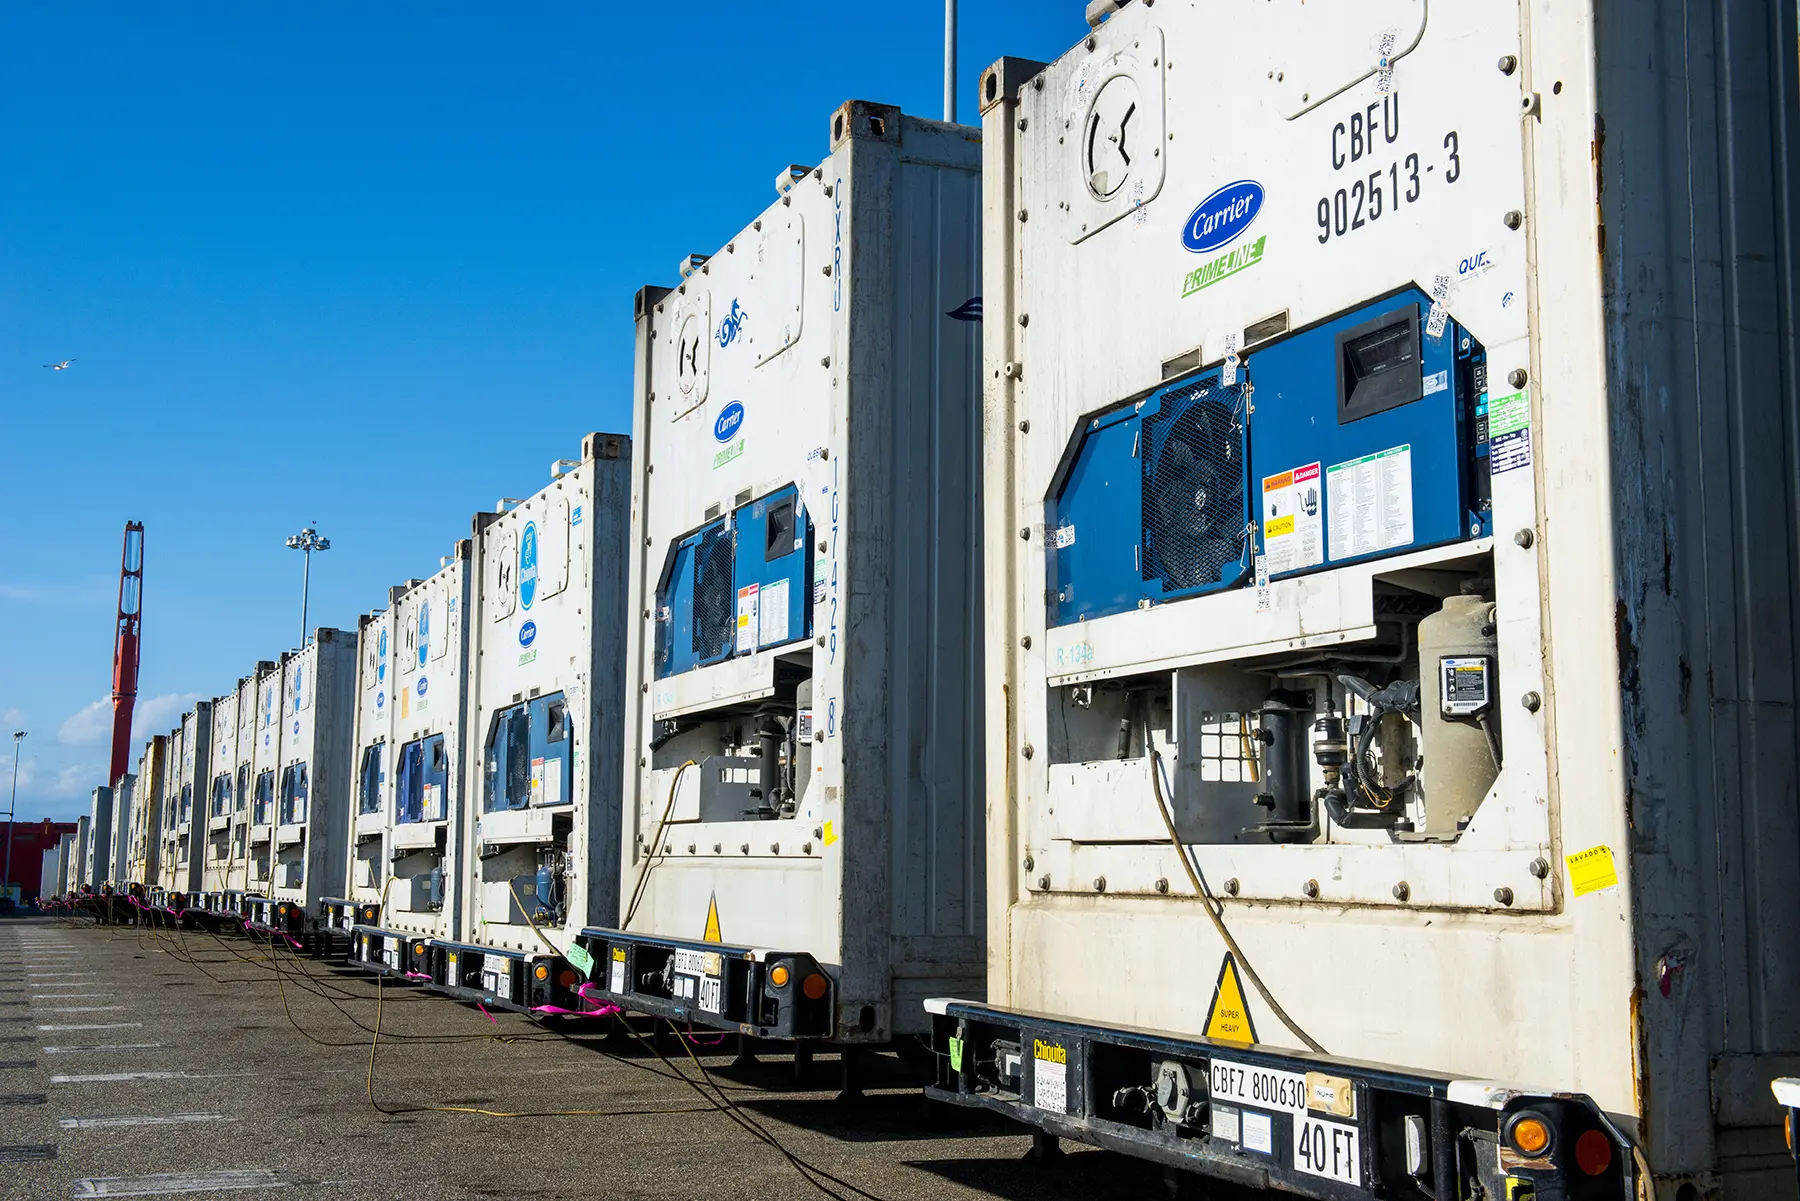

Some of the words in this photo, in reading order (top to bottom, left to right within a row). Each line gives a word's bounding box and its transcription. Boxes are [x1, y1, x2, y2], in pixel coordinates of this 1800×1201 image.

[1332, 91, 1399, 171] CBFU
[1317, 130, 1460, 245] 902513-3
[1192, 192, 1254, 240] Carrier
[717, 410, 741, 434] Carrier
[1271, 476, 1291, 486] WARNING
[1299, 466, 1319, 479] DANGER
[1273, 521, 1292, 532] CAUTION
[1570, 849, 1598, 864] LAVADO
[1220, 1009, 1240, 1019] SUPER
[1220, 1023, 1240, 1033] HEAVY
[1034, 1038, 1067, 1064] Chiquita
[1212, 1065, 1245, 1098] CBFZ
[1252, 1072, 1306, 1110] 800630
[1298, 1122, 1326, 1173] 40
[1332, 1127, 1354, 1179] FT
